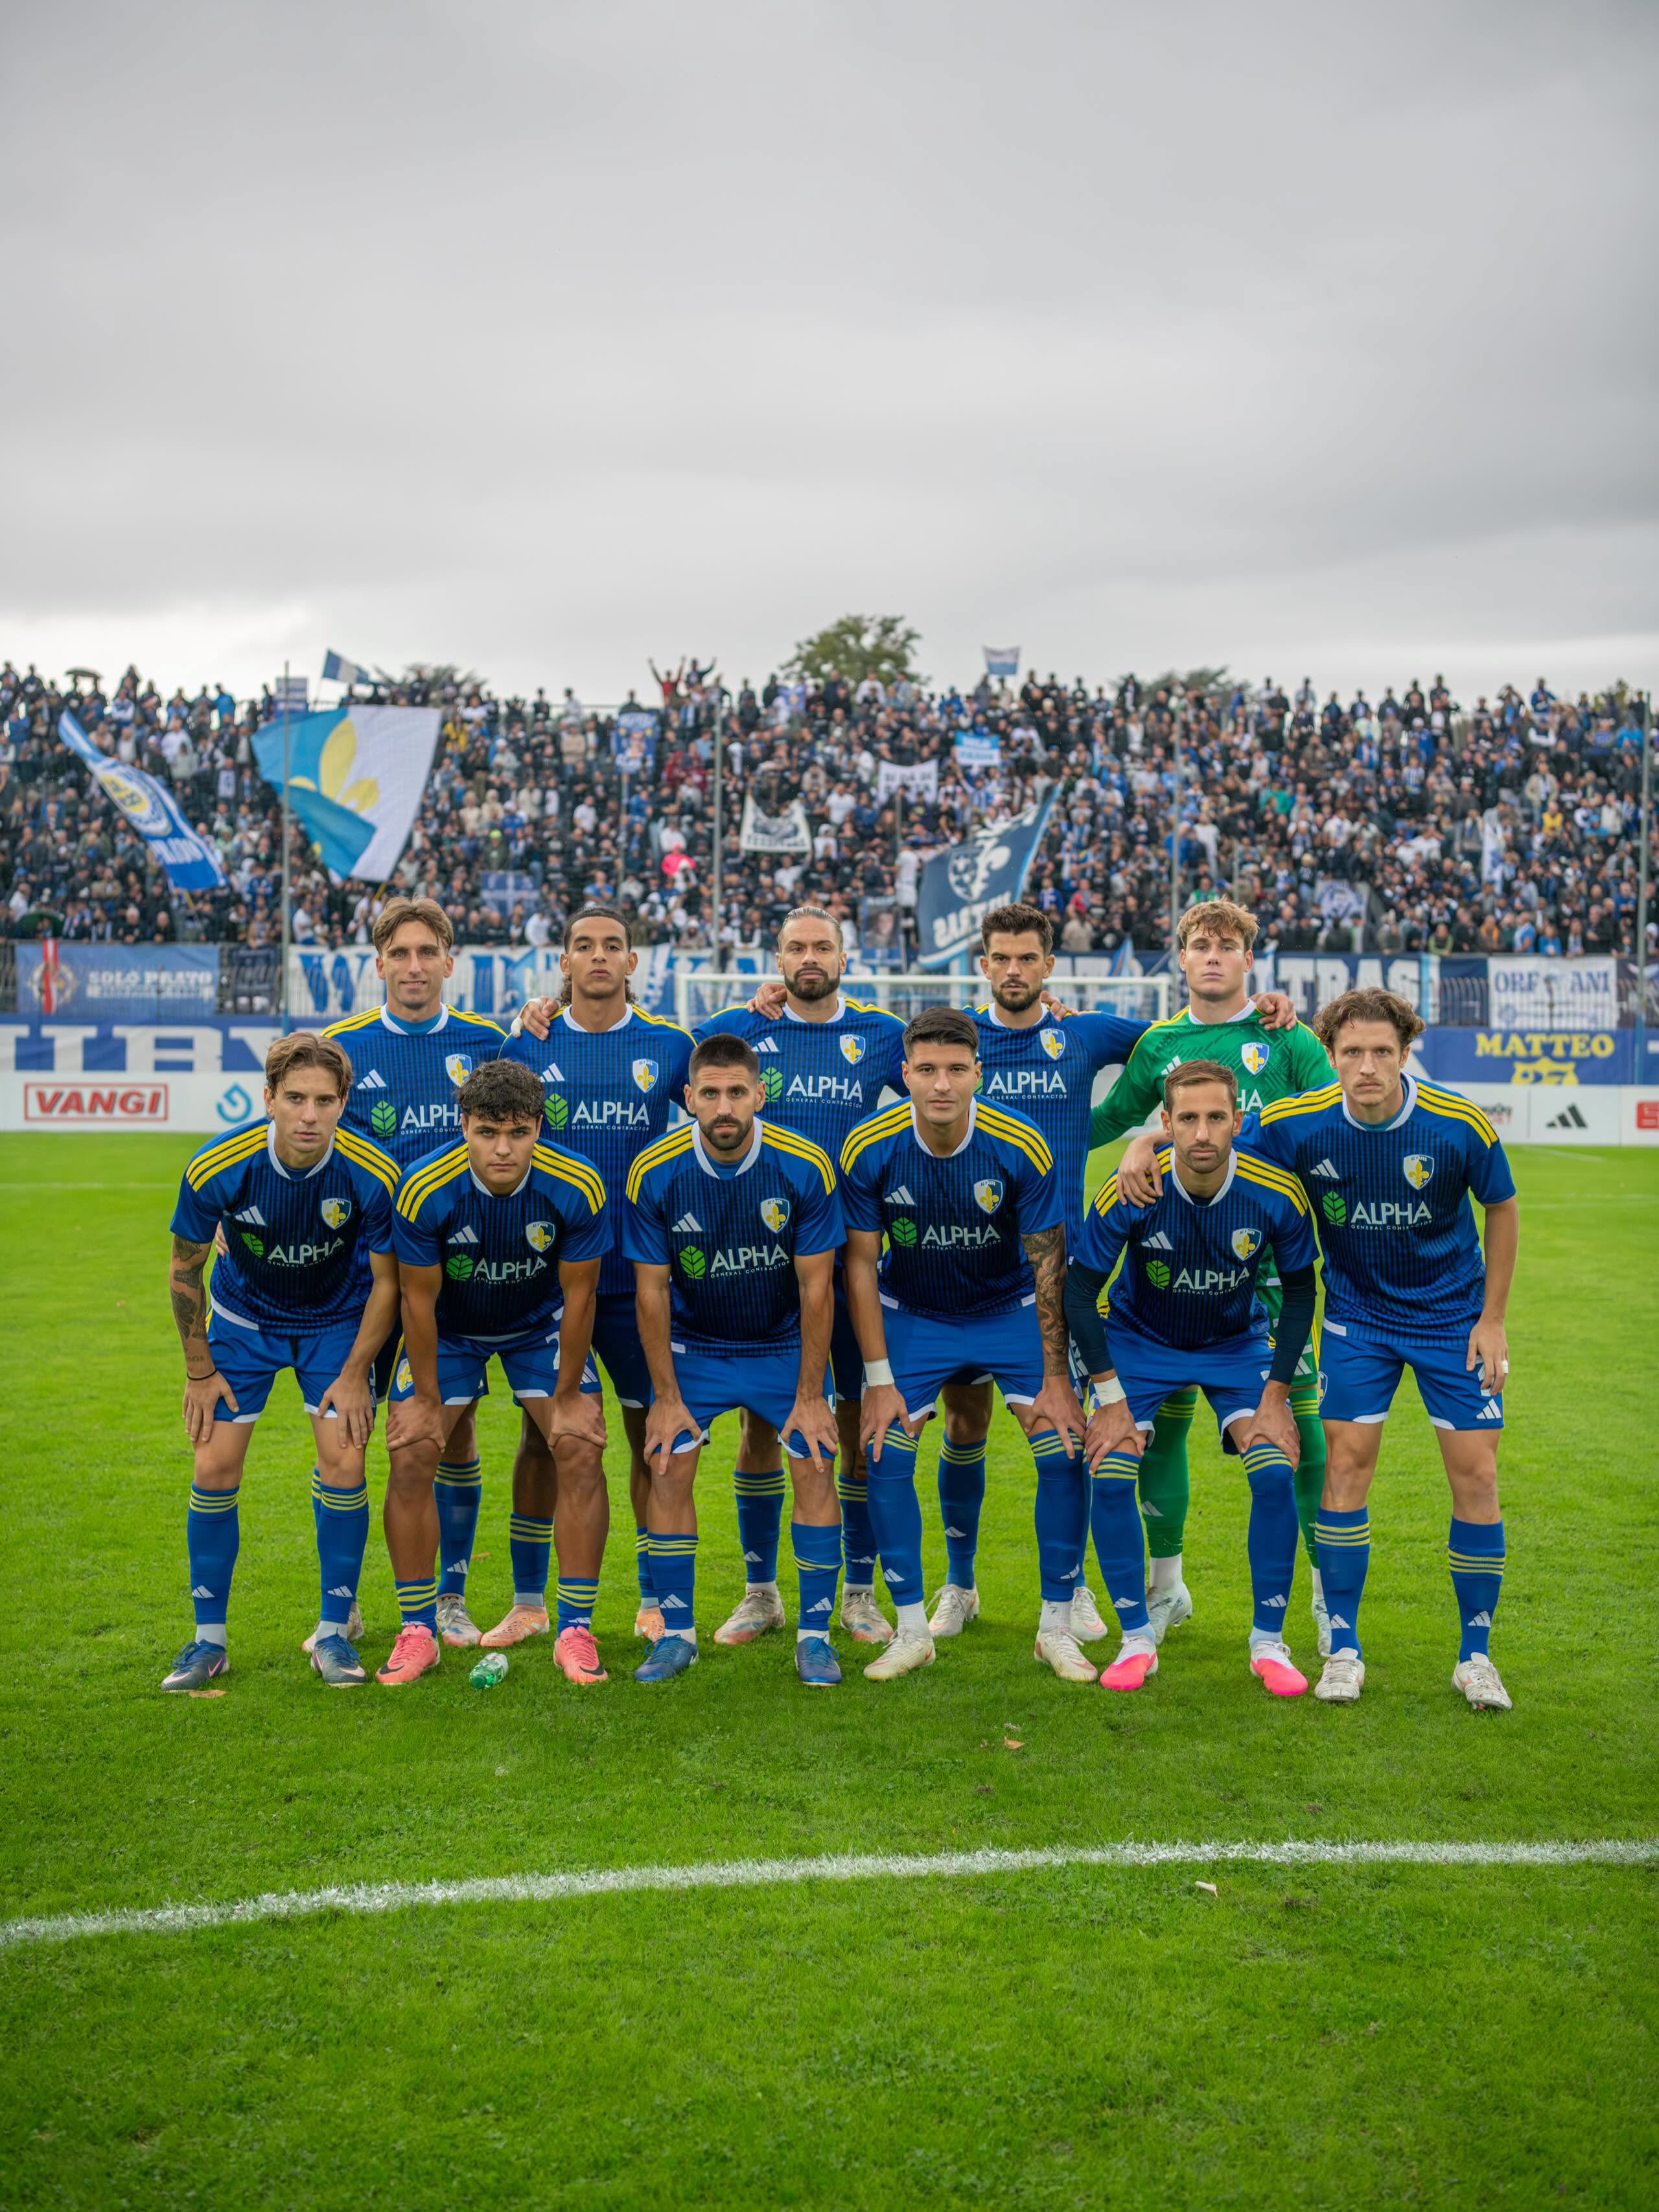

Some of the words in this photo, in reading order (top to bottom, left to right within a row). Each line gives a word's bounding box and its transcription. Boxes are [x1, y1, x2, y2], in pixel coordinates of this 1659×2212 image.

[89, 970, 139, 985] SOLO
[1475, 1032, 1615, 1058] MATTEO
[786, 1074, 863, 1102] ALPHA
[987, 1070, 1067, 1095] ALPHA
[35, 1090, 161, 1114] VANGI
[572, 1100, 650, 1126] ALPHA
[821, 1099, 863, 1108] CONTRACTOR
[1351, 1201, 1433, 1225] ALPHA
[922, 1223, 1001, 1246] ALPHA
[267, 1237, 345, 1264] ALPHA
[710, 1243, 790, 1273] ALPHA
[474, 1257, 548, 1281] ALPHA
[745, 1260, 791, 1274] CONTRACTOR
[1172, 1266, 1250, 1291] ALPHA
